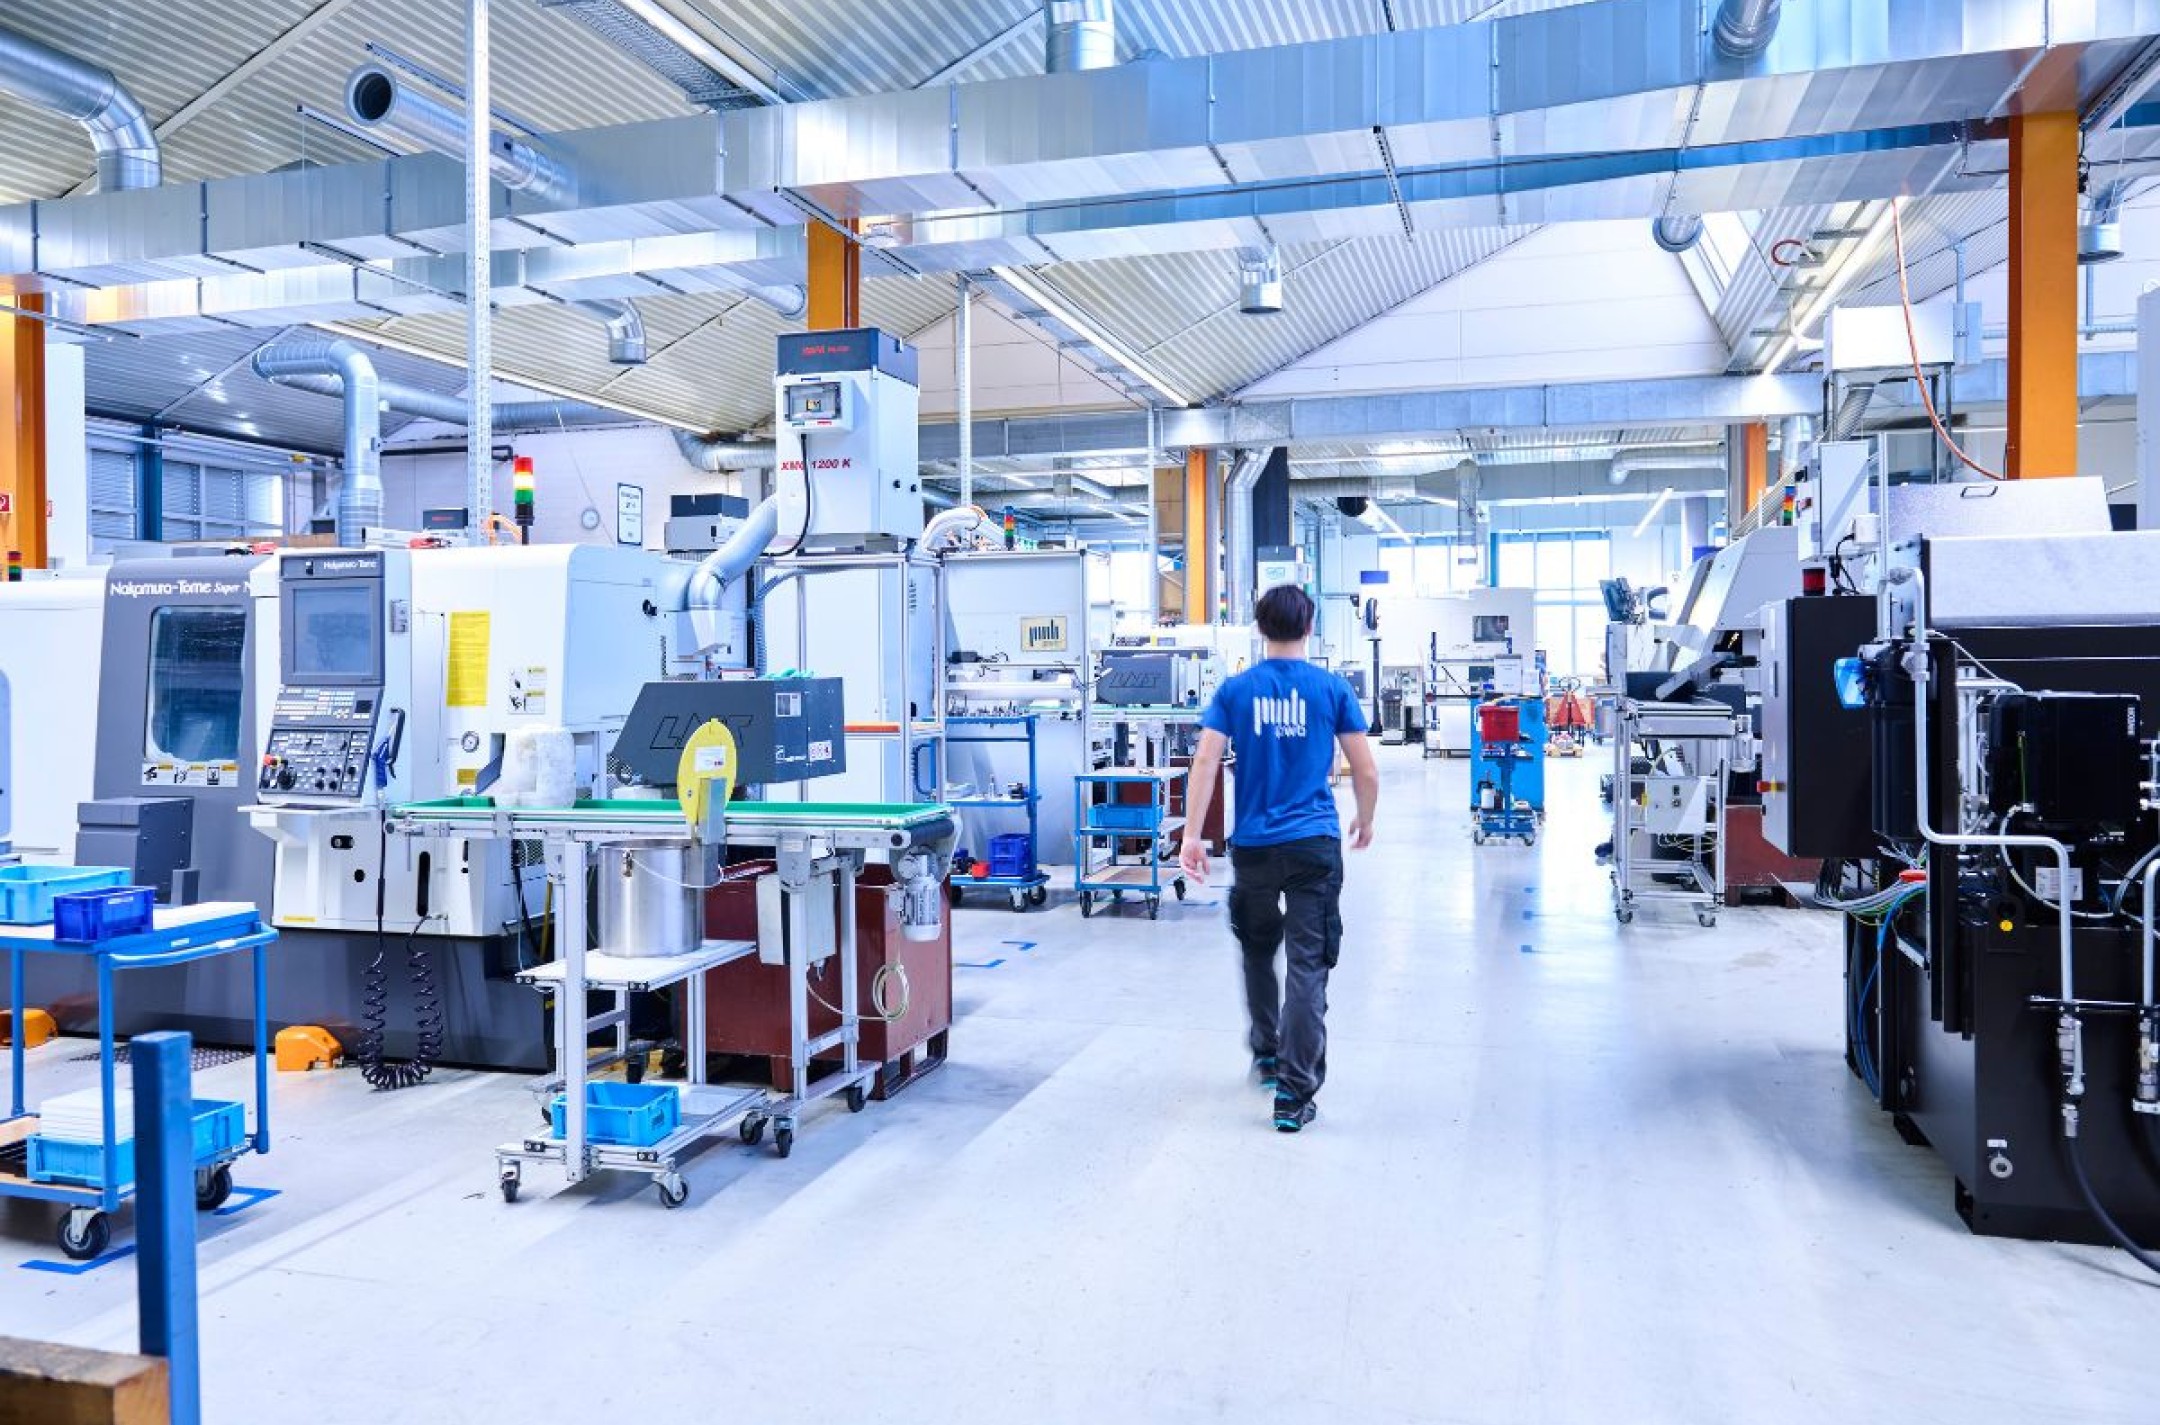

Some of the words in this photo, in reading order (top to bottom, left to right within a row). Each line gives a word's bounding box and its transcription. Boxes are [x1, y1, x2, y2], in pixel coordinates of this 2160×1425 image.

[812, 459, 839, 469] 1200
[110, 579, 212, 598] Nakamura-Tome
[213, 582, 241, 597] Super
